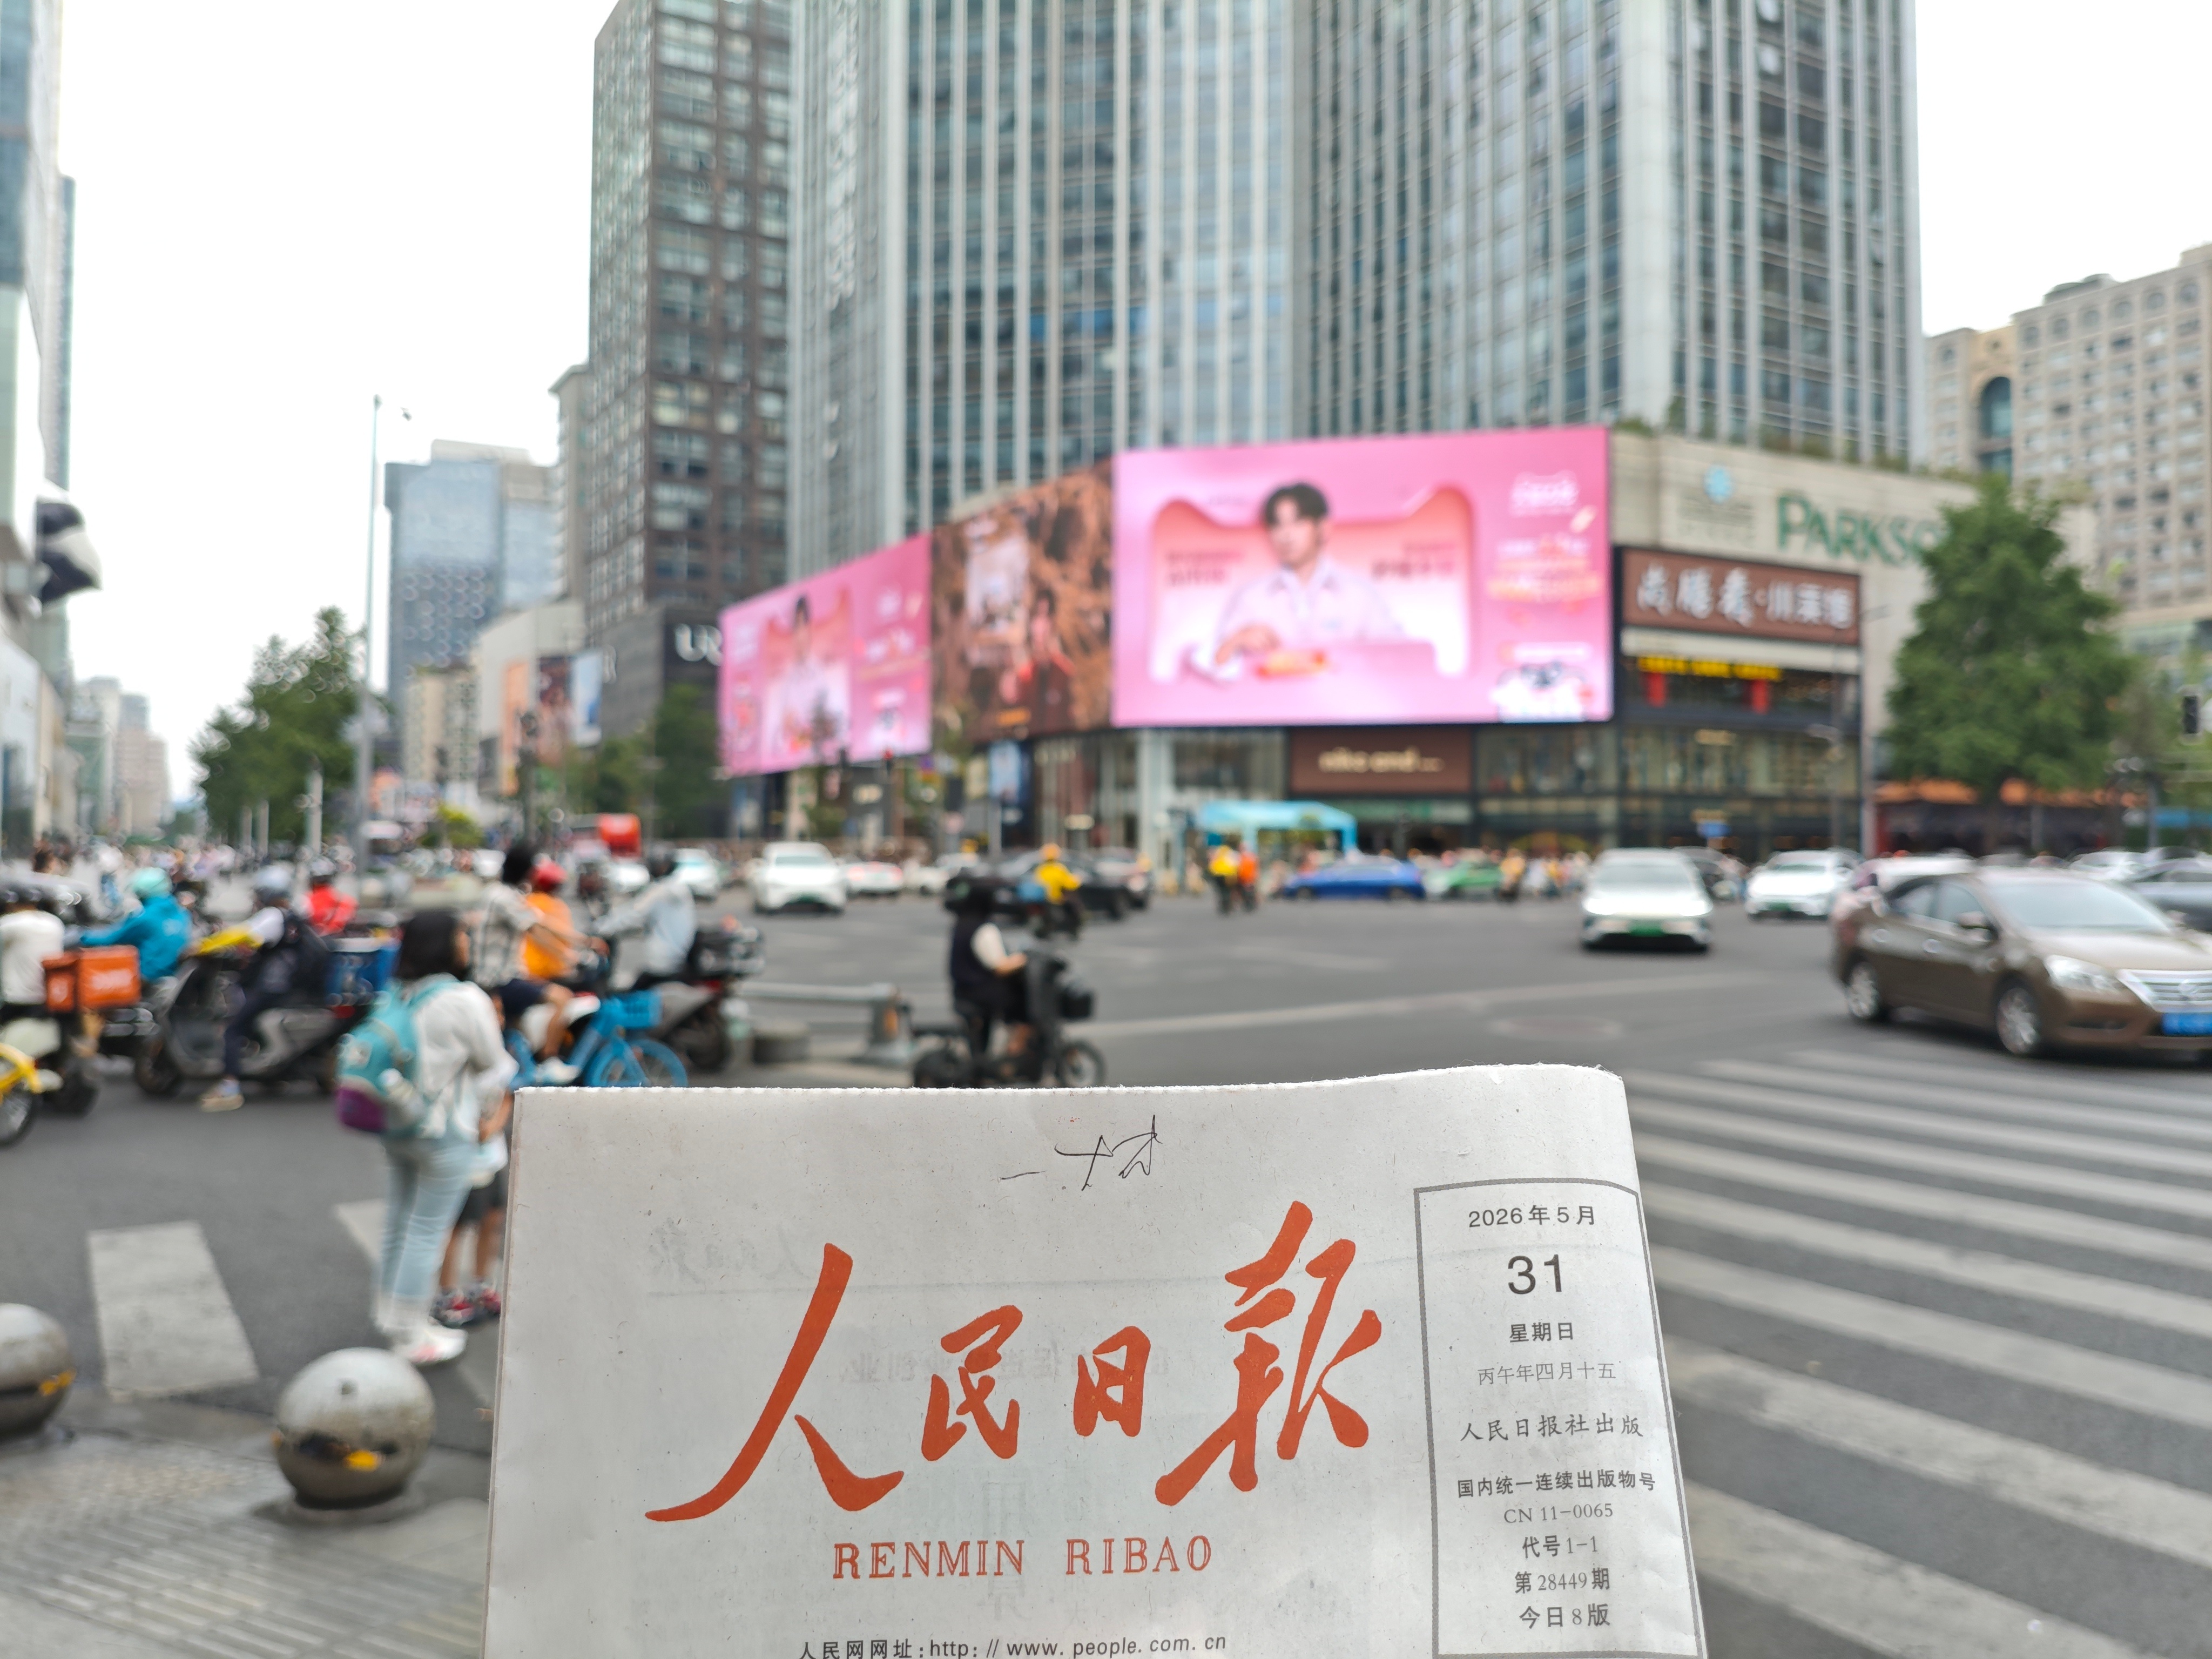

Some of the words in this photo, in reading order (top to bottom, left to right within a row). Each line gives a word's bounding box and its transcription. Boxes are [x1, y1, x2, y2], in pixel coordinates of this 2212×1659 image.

[1776, 491, 1951, 565] PARKSO
[1469, 1205, 1595, 1228] 2026年5月
[1508, 1254, 1562, 1294] 31
[1509, 1322, 1574, 1343] 星期日
[645, 1201, 1381, 1522] 人民日報
[1478, 1361, 1616, 1386] 丙午年四月十五
[1460, 1412, 1643, 1441] 人民日报社出版
[1458, 1469, 1656, 1498] 国内统一连续出版物号
[1504, 1508, 1533, 1524] CN
[1541, 1503, 1613, 1521] 11-0065
[833, 1541, 1023, 1579] RENMIN
[1067, 1536, 1211, 1575] RIBAO
[1522, 1535, 1599, 1559] 代号1-1
[1515, 1566, 1610, 1594] 第28449期
[1519, 1603, 1610, 1629] 今日8版
